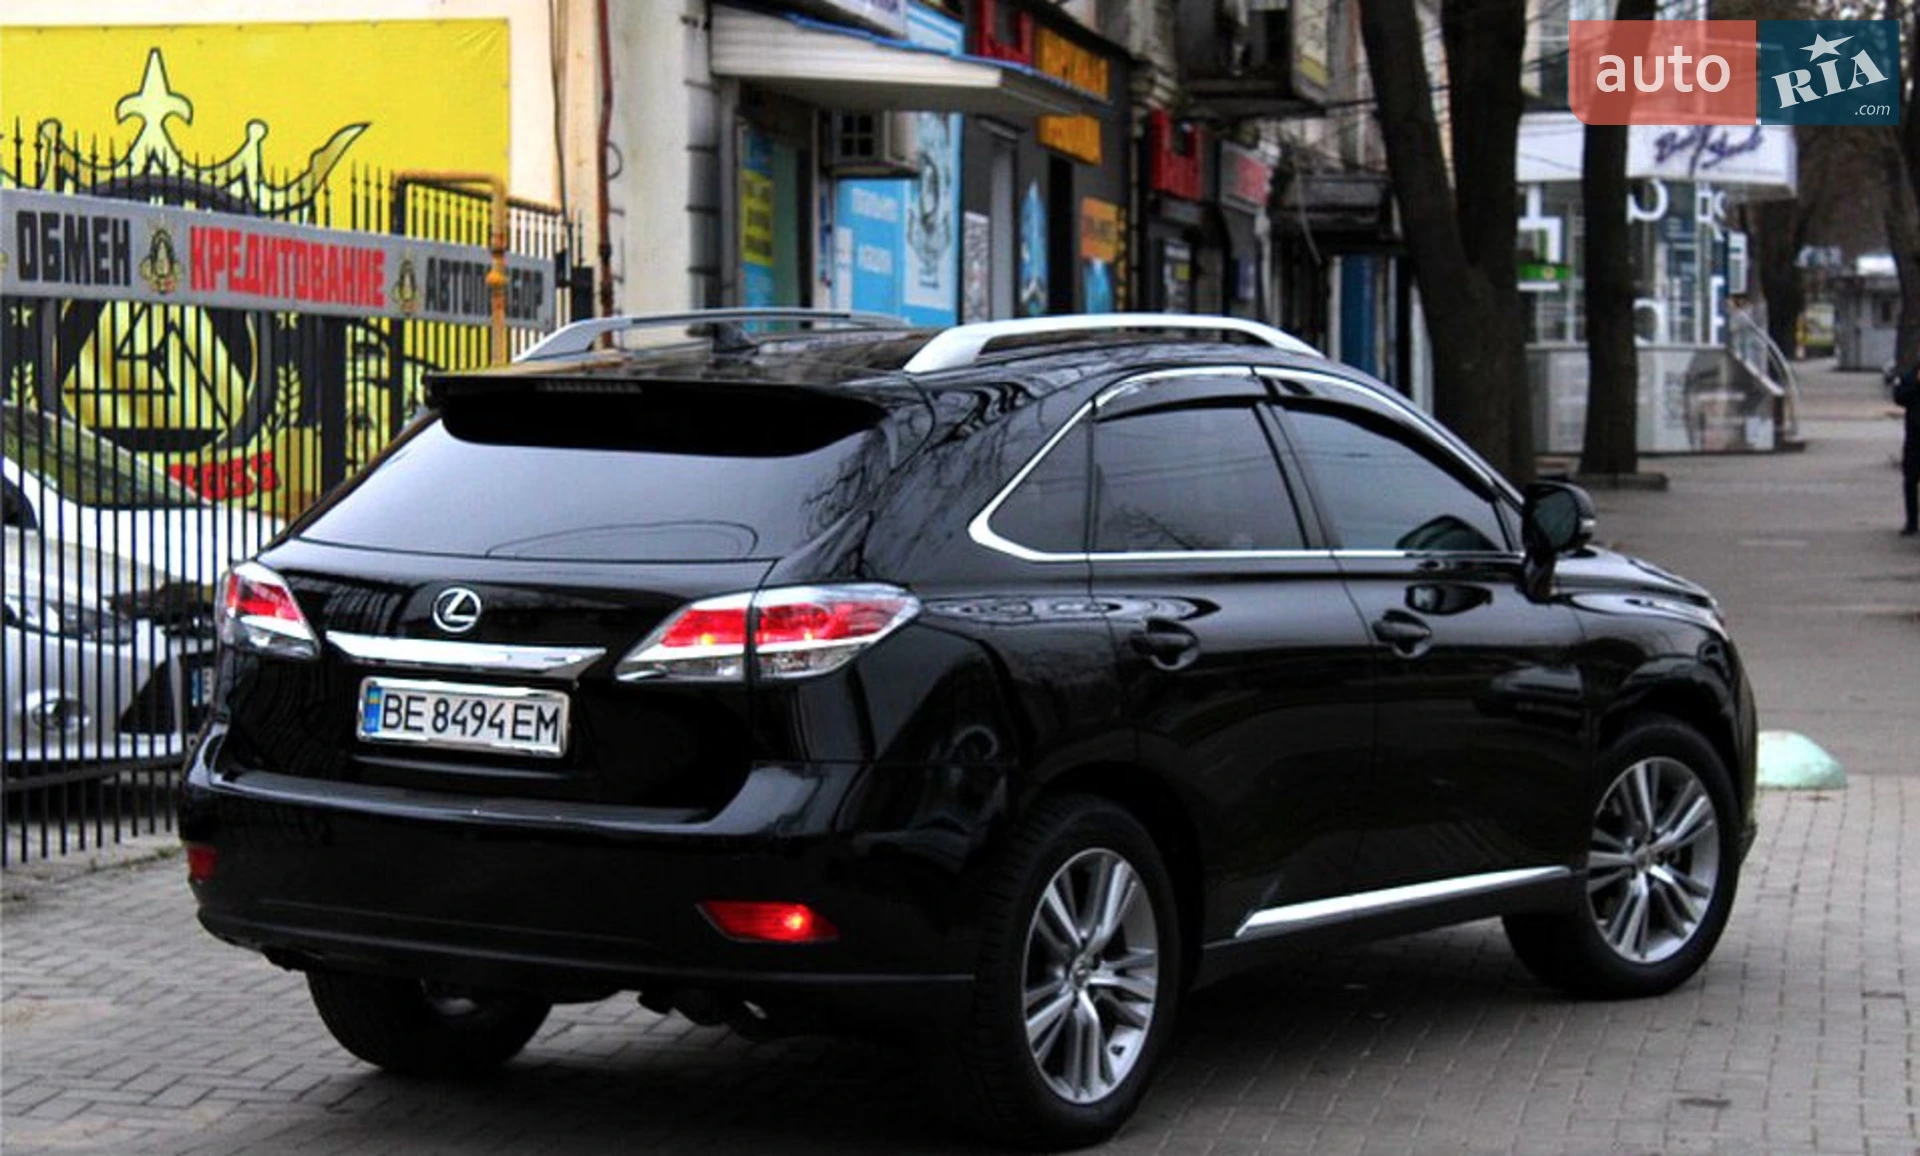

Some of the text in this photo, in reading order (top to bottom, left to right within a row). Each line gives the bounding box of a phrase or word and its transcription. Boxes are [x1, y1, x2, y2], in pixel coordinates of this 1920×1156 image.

[15, 210, 544, 320] ОБМЕН КРЕДИТОВАНИЕ АВТОПБОР
[383, 693, 560, 744] BE 8494 EM
